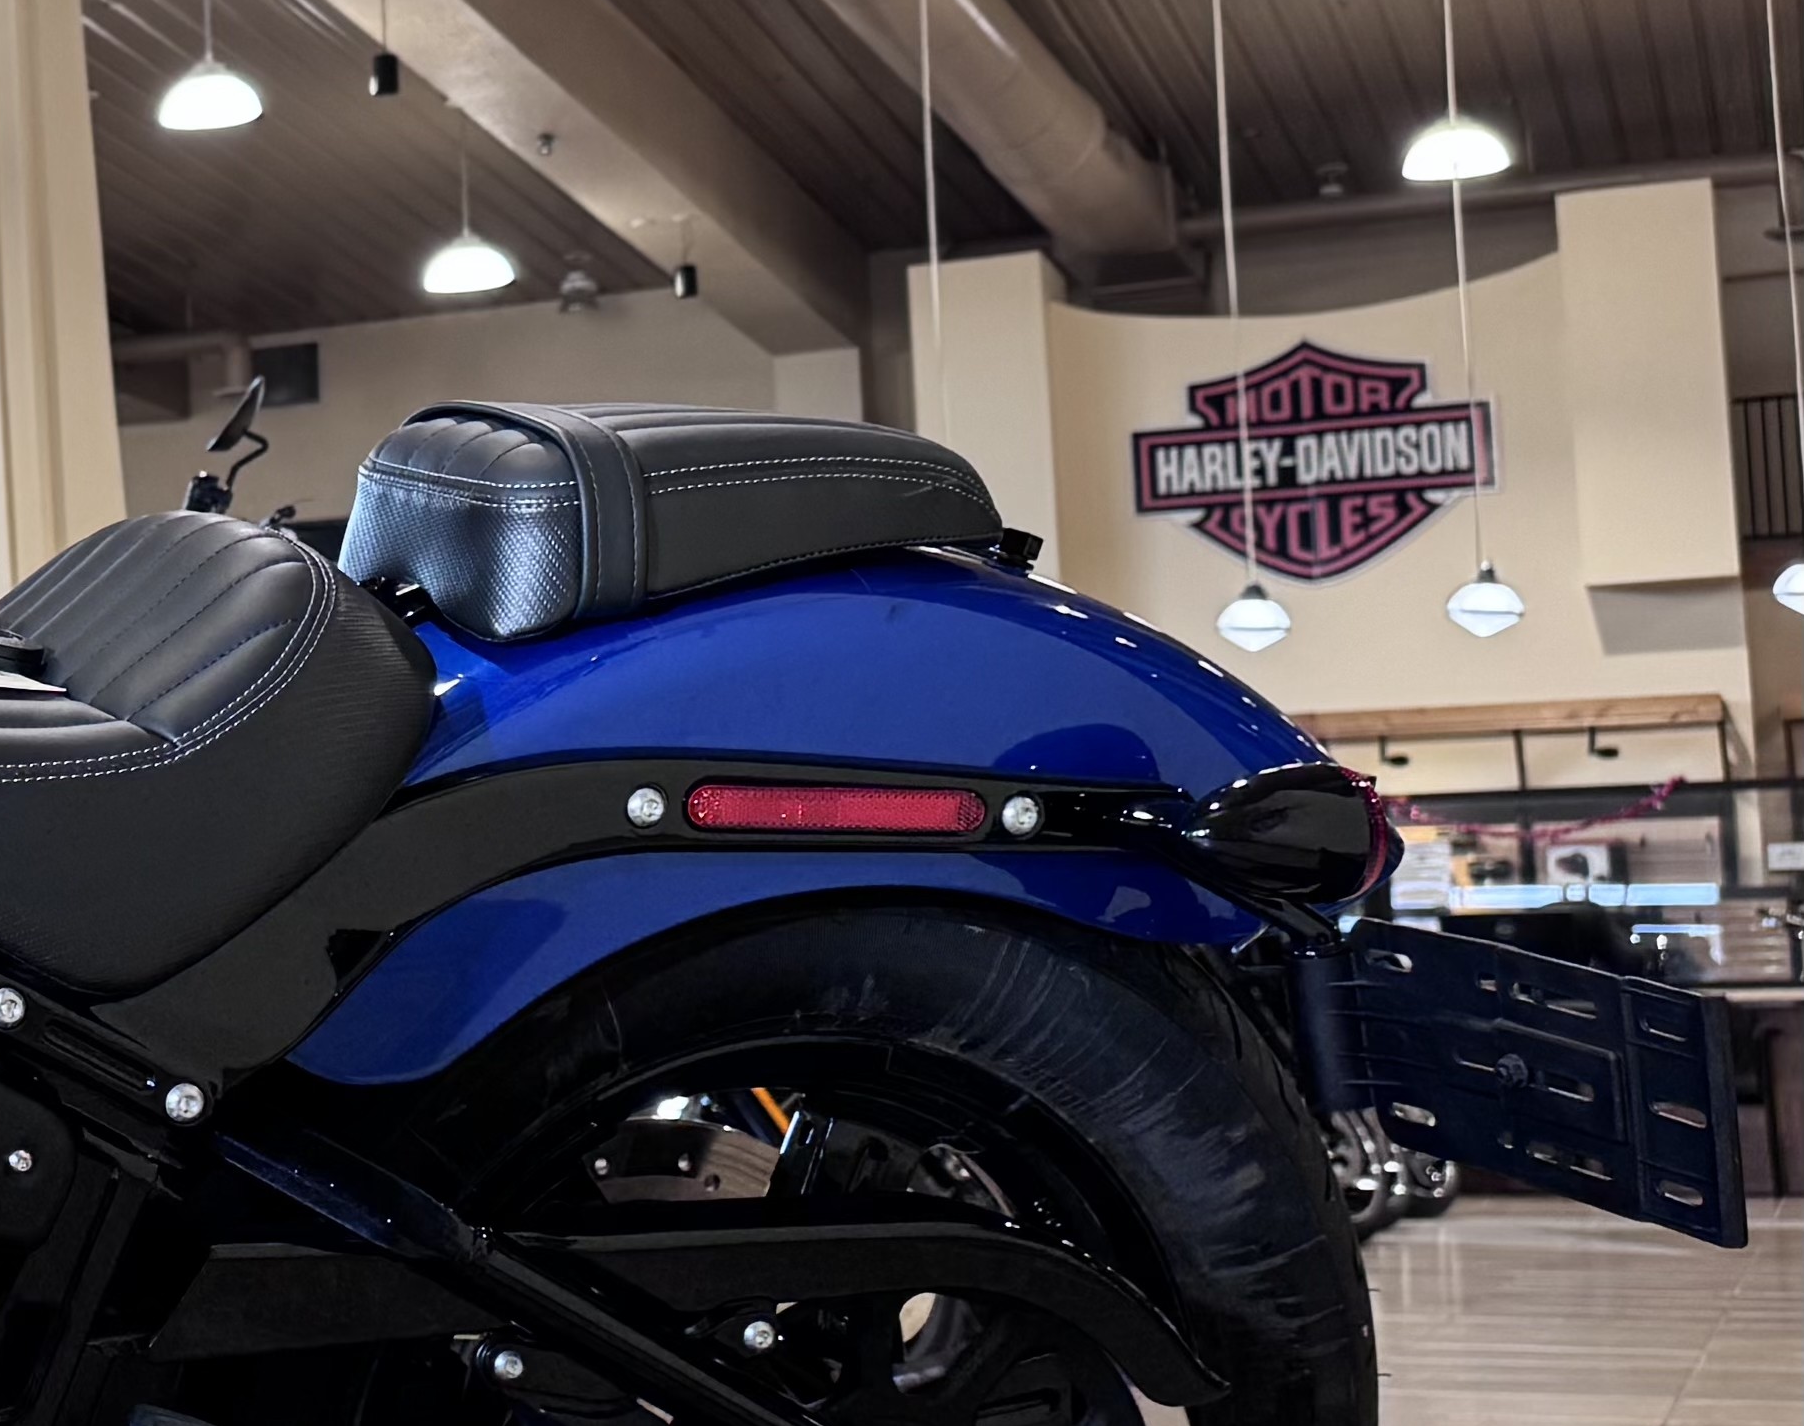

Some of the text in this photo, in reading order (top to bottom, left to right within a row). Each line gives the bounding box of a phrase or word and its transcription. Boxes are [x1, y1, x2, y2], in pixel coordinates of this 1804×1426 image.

[1222, 369, 1396, 426] MOTOR
[1153, 419, 1472, 497] HARLEY-DAVIDSON
[1227, 493, 1402, 564] CYCLES
